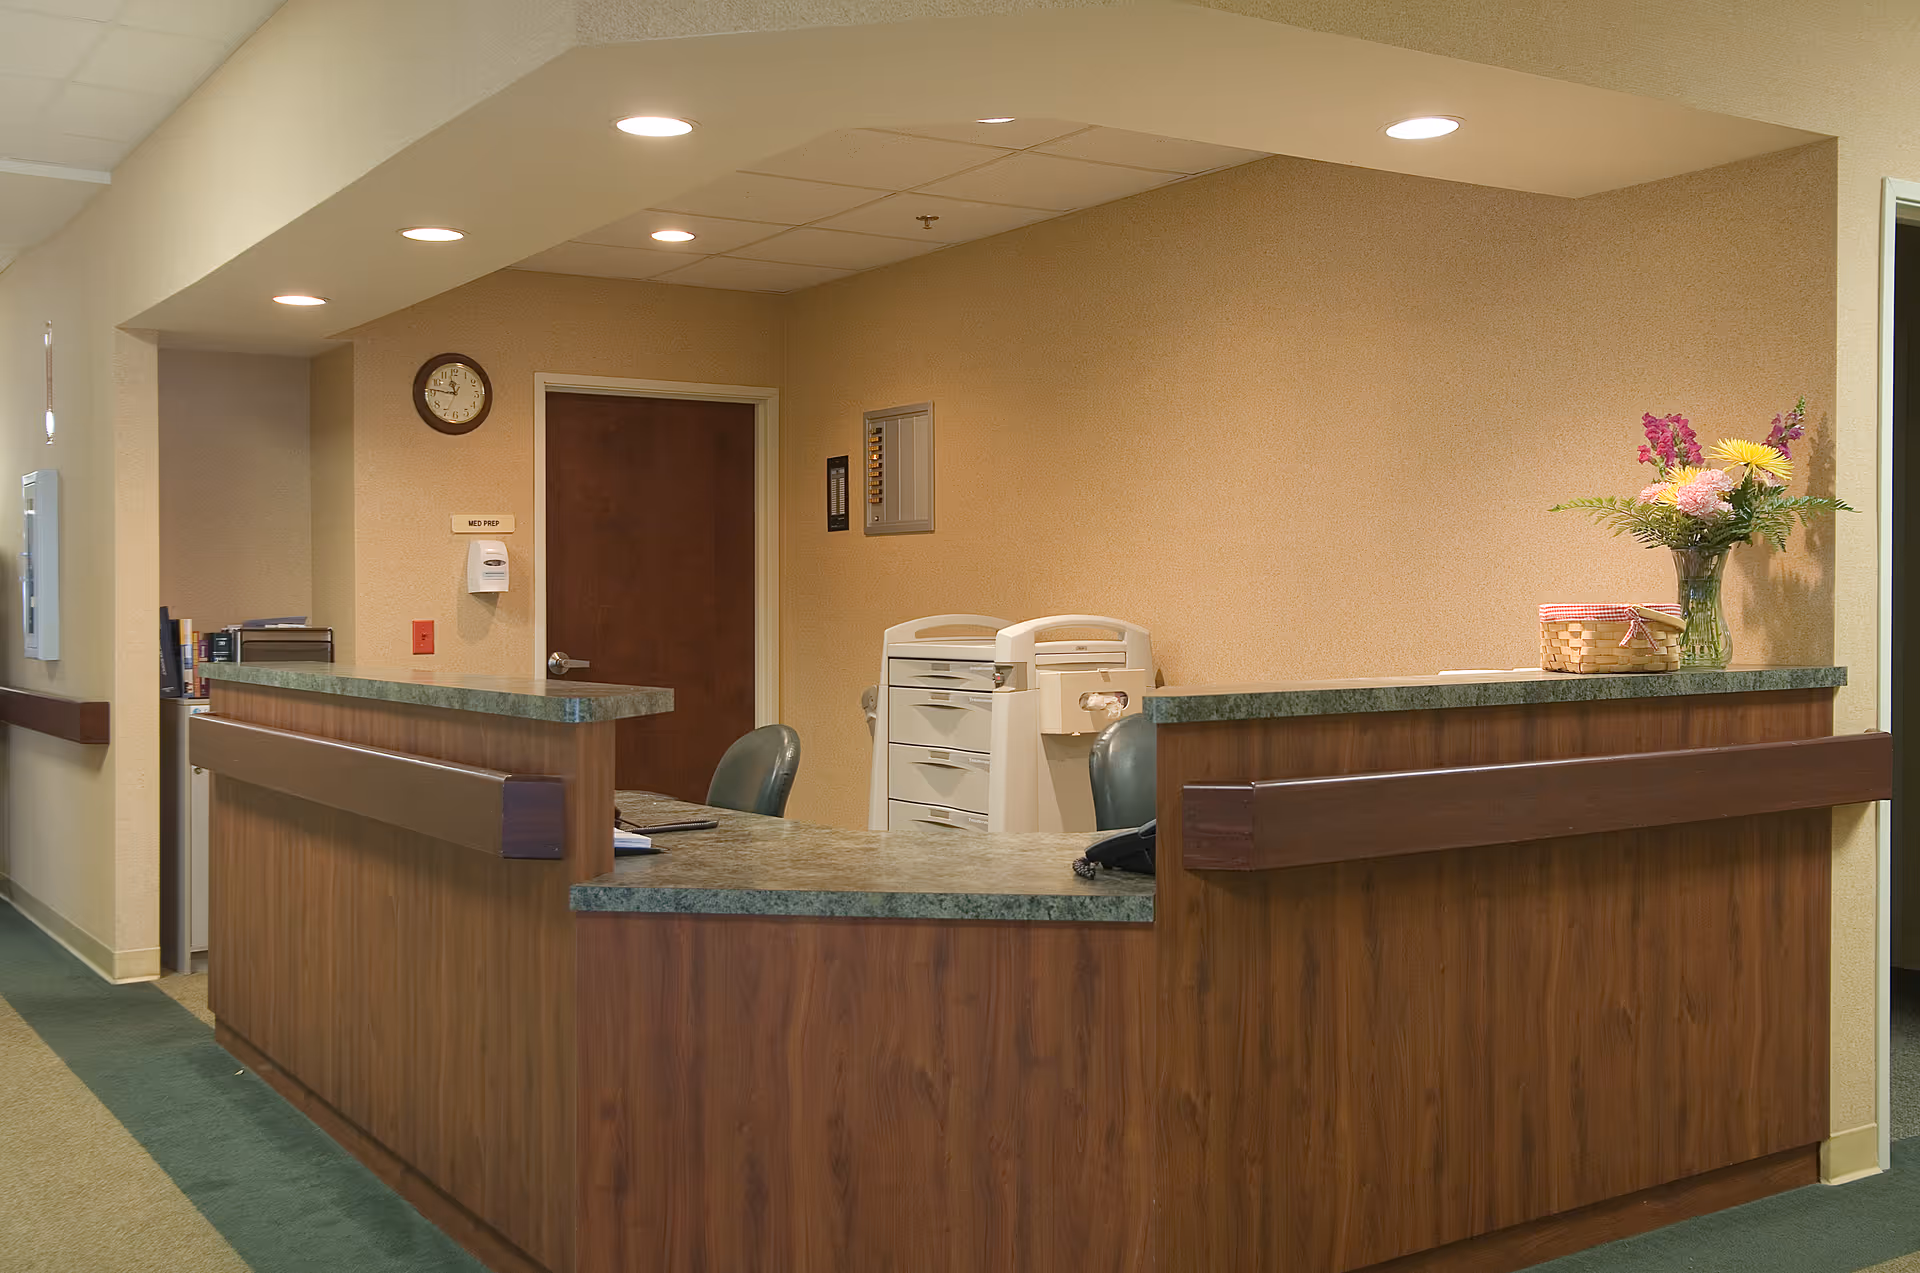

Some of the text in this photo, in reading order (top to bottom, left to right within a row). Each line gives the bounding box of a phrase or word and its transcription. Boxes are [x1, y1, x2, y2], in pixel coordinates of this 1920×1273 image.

[441, 371, 447, 379] 11
[450, 368, 459, 377] 12
[433, 378, 441, 387] 10
[470, 379, 476, 388] 2
[430, 388, 437, 398] 9
[473, 390, 480, 399] 3
[434, 400, 440, 409] 8
[470, 401, 476, 409] 4
[443, 408, 449, 417] 7
[452, 410, 459, 419] 6
[463, 408, 470, 417] 5
[468, 519, 500, 527] MED PREP
